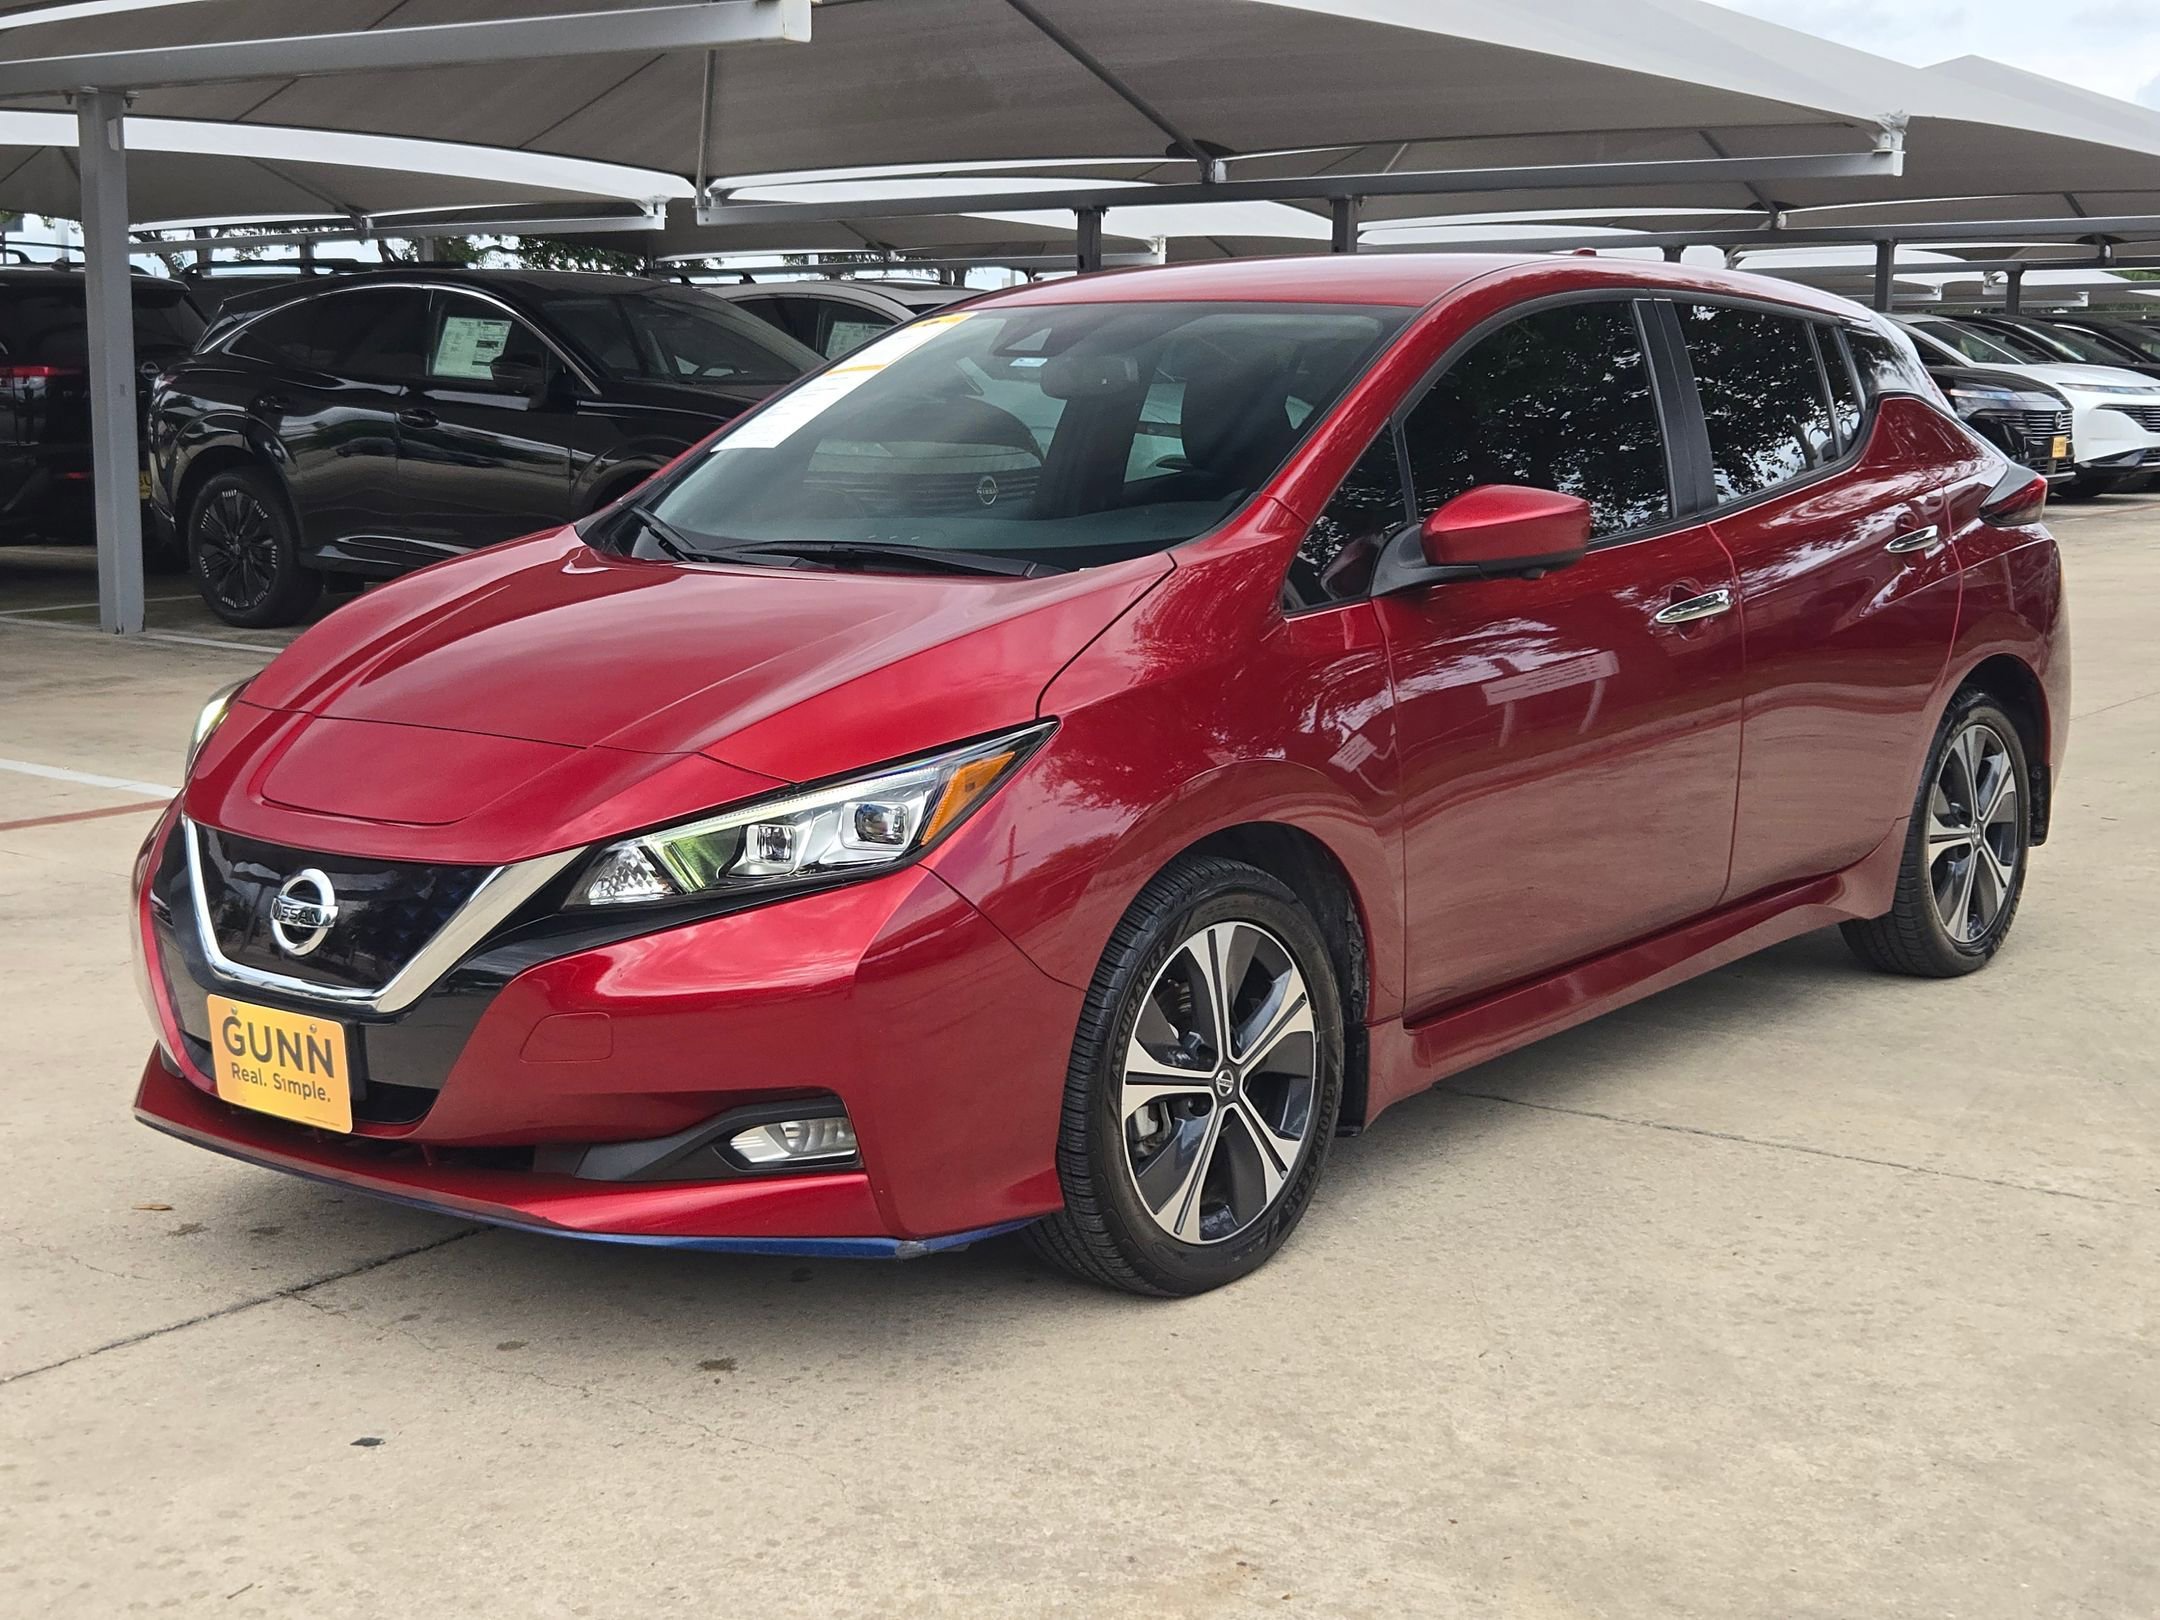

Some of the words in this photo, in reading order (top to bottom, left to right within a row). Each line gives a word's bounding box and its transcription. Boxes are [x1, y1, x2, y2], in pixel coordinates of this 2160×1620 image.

[222, 1015, 335, 1078] GUNN
[231, 1063, 267, 1087] Real.
[273, 1072, 332, 1102] Simple.
